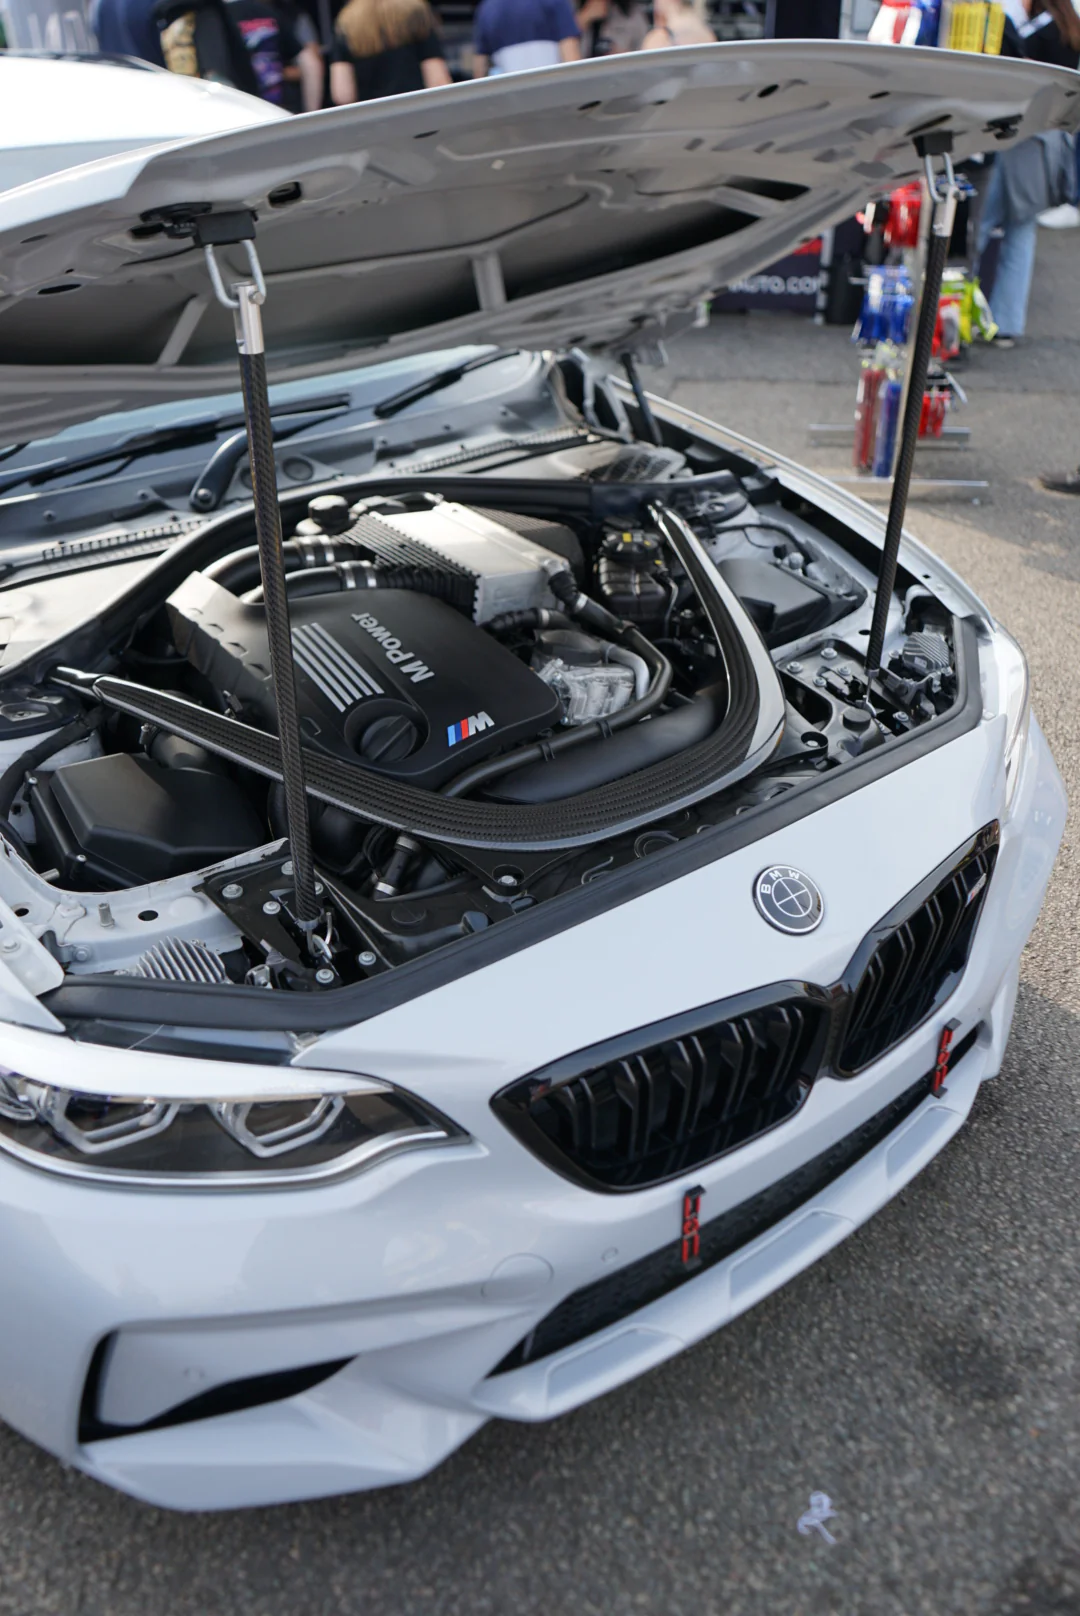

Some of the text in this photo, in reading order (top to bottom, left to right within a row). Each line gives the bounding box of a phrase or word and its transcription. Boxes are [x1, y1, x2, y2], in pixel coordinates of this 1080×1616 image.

[351, 612, 435, 683] M Power
[760, 869, 800, 895] BMW
